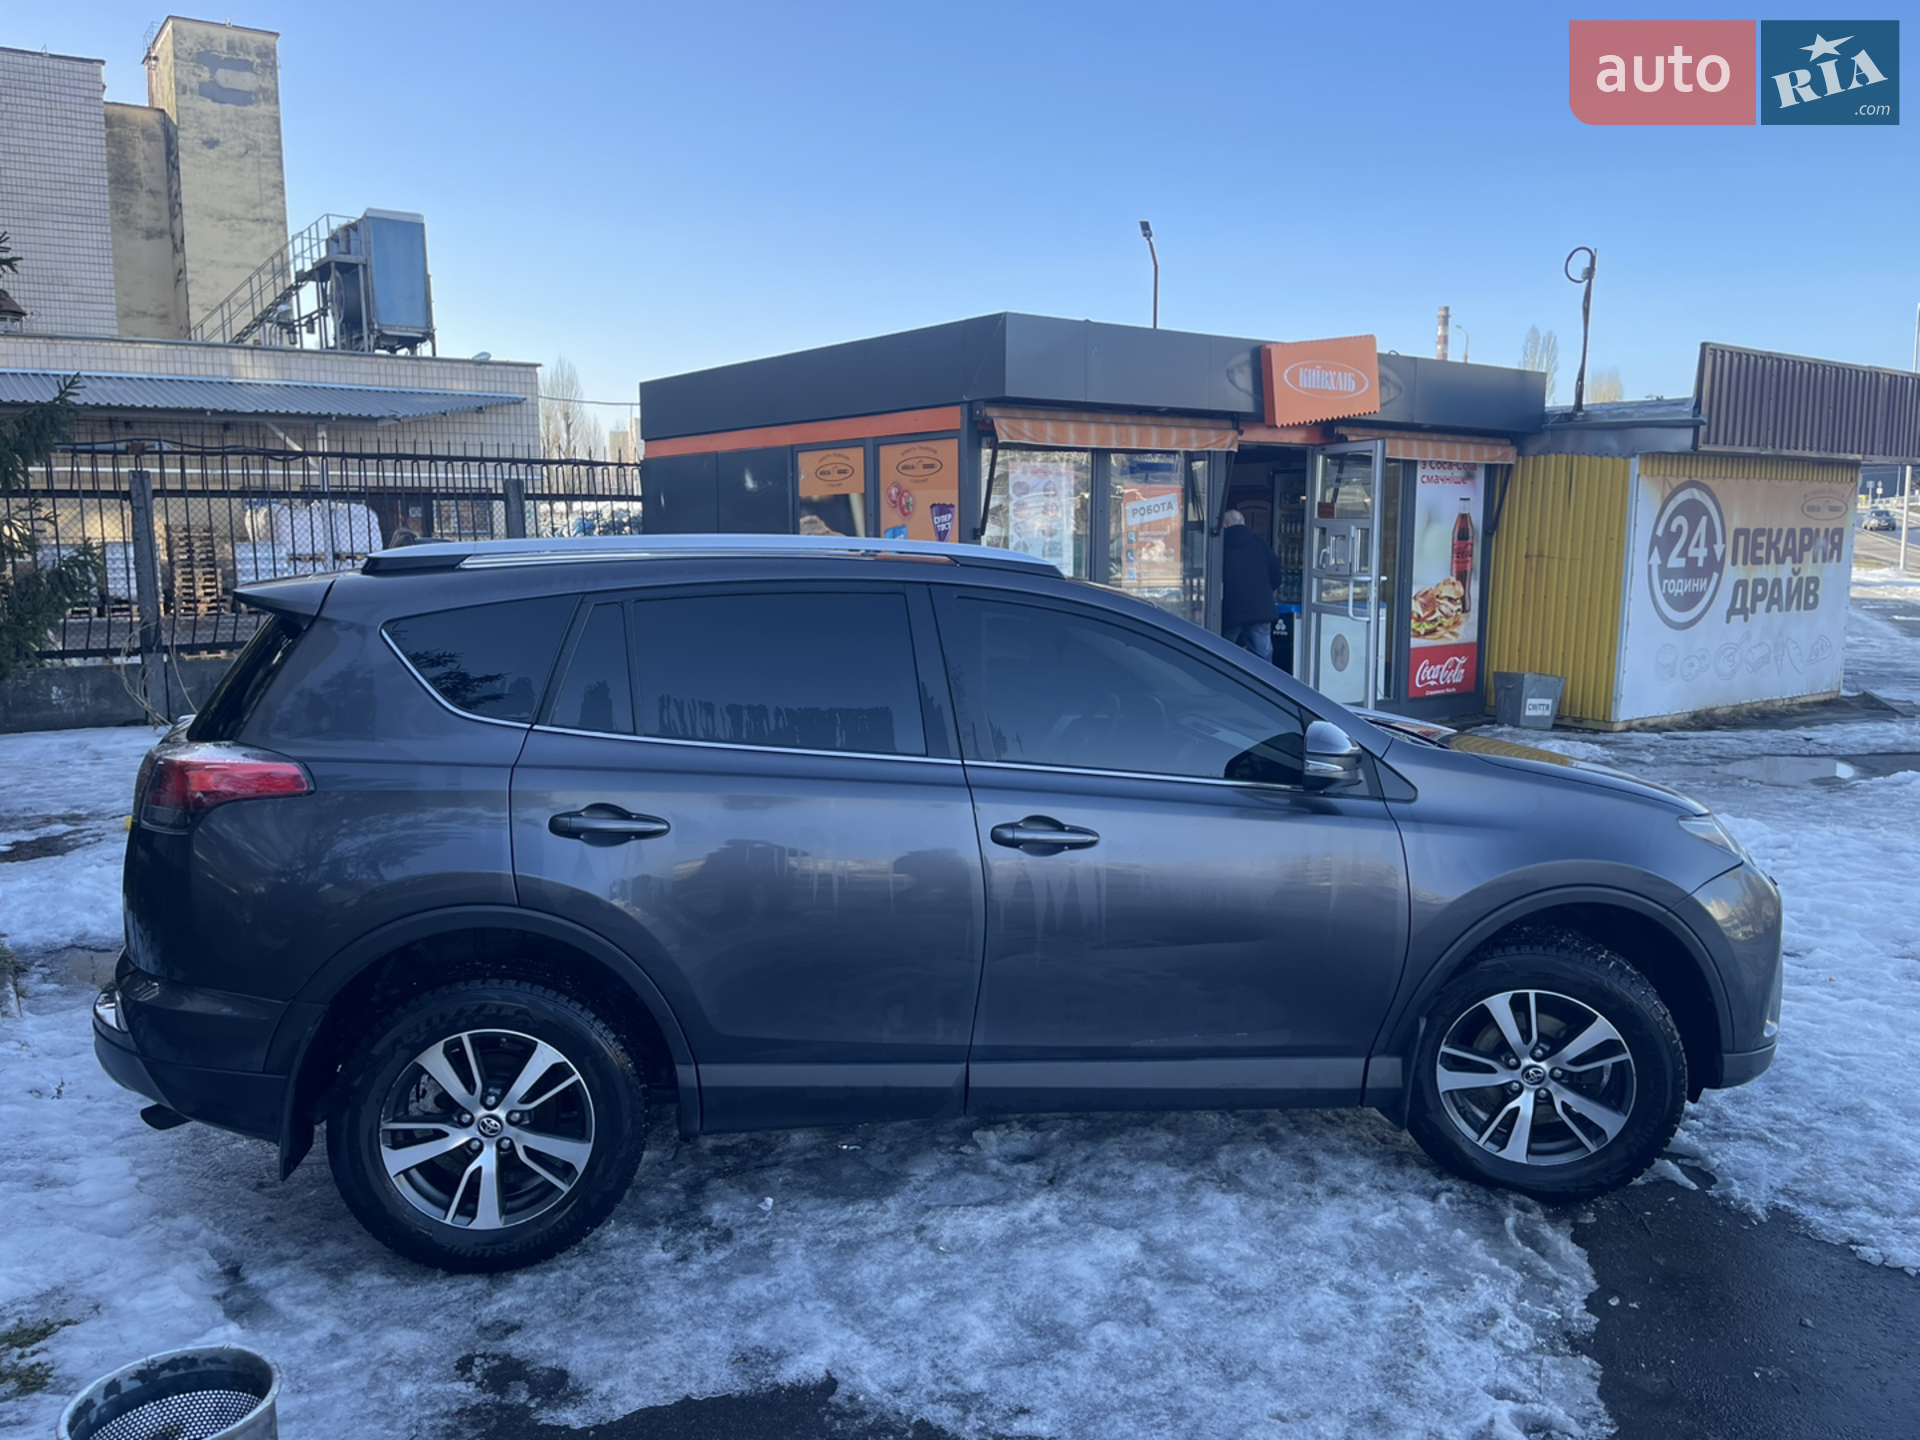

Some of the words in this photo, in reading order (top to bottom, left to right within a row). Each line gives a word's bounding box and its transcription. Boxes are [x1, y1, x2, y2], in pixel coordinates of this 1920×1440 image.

[1131, 501, 1174, 518] РОБОТА
[1666, 515, 1708, 568] 24
[1731, 527, 1844, 566] ПЕКАРНЯ
[1725, 567, 1820, 624] ДРАЙВ
